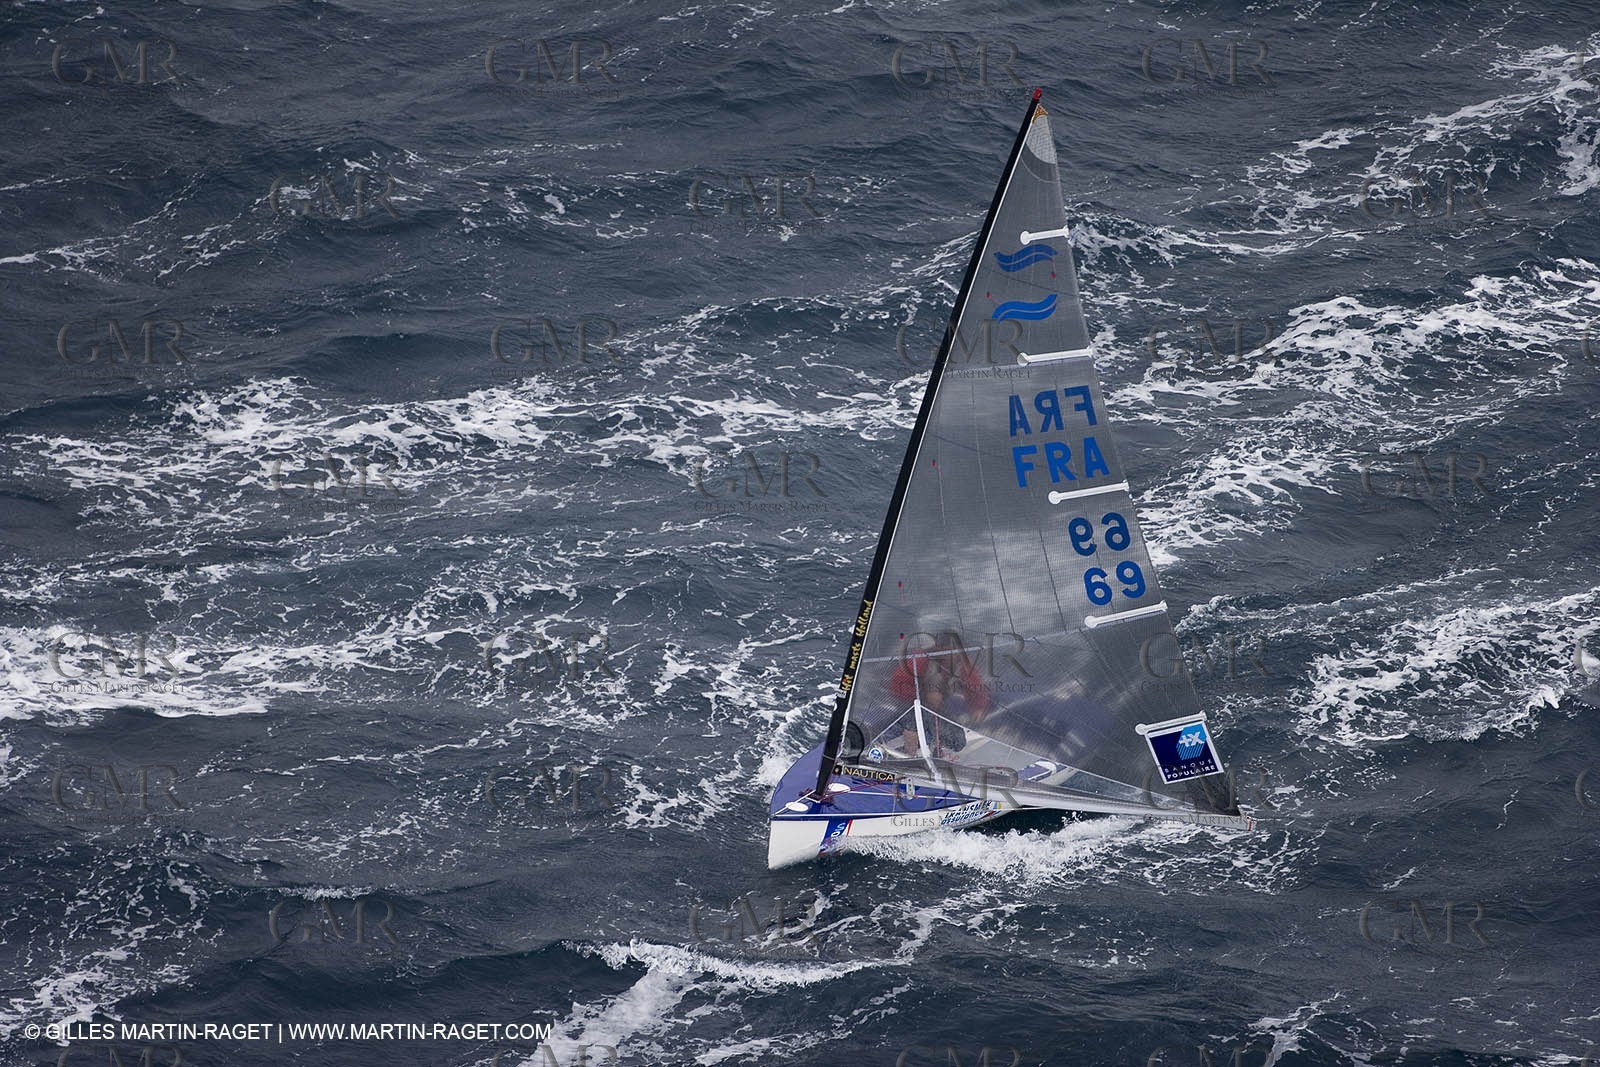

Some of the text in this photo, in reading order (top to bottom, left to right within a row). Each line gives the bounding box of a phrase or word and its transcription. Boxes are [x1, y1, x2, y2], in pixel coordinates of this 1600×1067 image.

[1012, 437, 1110, 488] FRA
[1083, 560, 1146, 606] 69
[856, 599, 874, 637] Holland
[844, 767, 895, 782] NAUTICA
[1167, 765, 1216, 779] POPULAIRE
